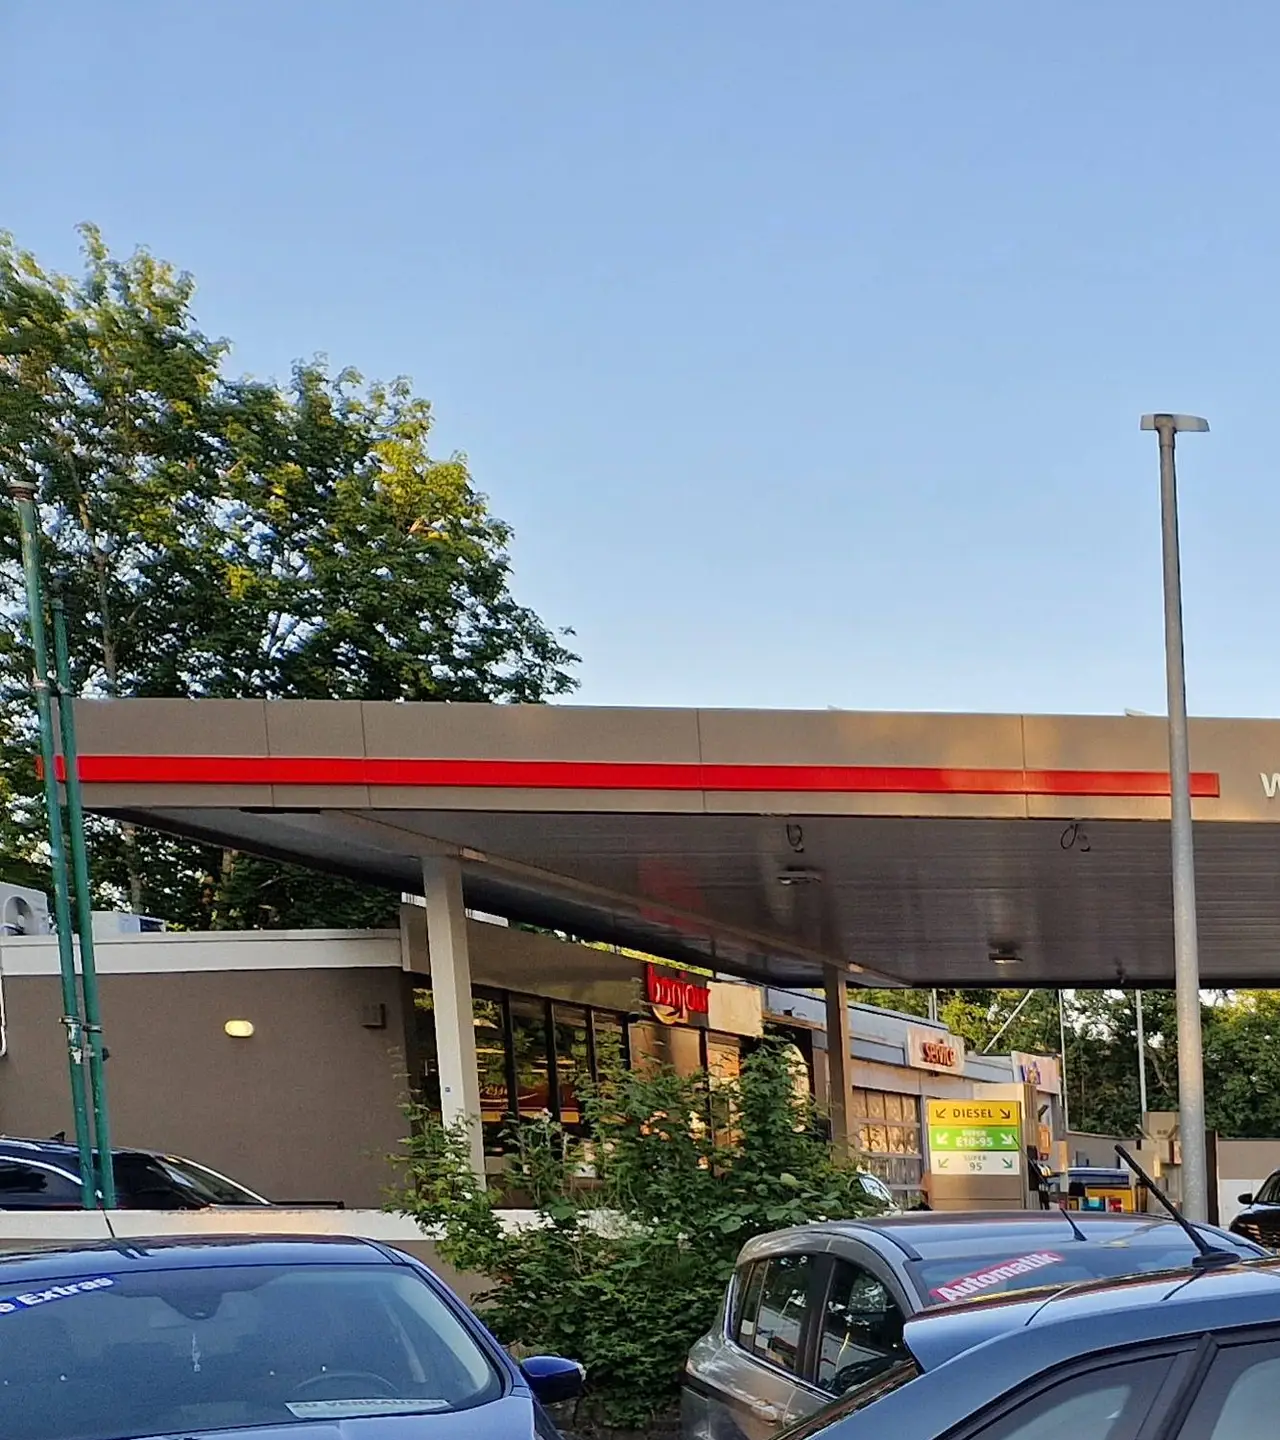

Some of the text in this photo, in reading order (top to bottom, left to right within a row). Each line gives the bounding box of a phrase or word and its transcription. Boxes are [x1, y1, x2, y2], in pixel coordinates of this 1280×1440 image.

[646, 963, 710, 1022] bonjour
[922, 1040, 957, 1067] service
[952, 1108, 995, 1119] DIESEL
[955, 1137, 993, 1148] E10-95
[963, 1153, 987, 1161] SUPER
[969, 1161, 983, 1172] 95
[936, 1252, 1061, 1301] Automatik
[16, 1277, 114, 1306] Extras
